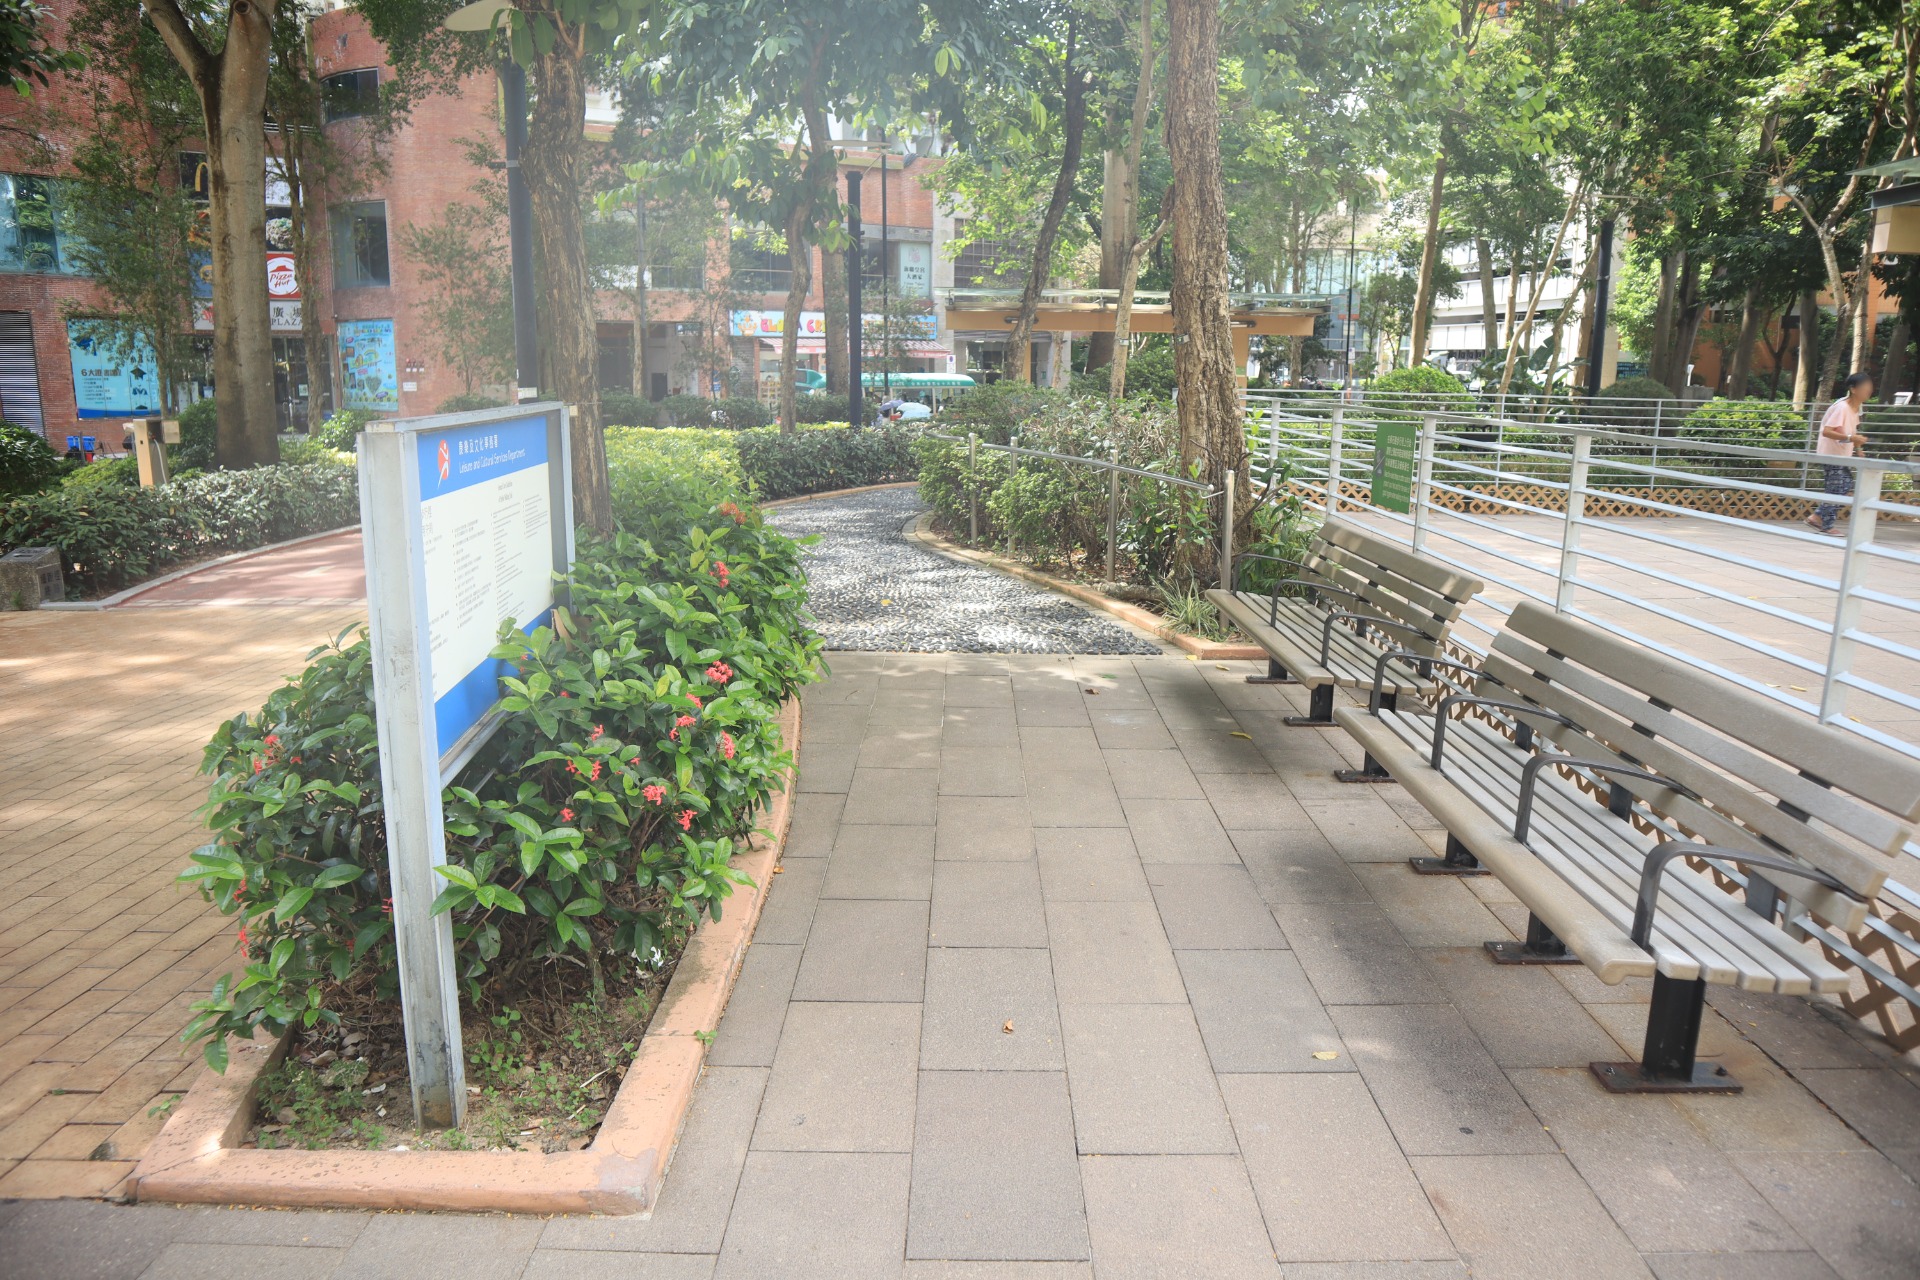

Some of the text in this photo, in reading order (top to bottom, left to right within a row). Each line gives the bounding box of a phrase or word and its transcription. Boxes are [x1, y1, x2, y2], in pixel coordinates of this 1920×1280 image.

[269, 272, 293, 284] Pizza
[274, 278, 291, 288] Hut
[459, 461, 473, 474] Leisure
[480, 455, 494, 468] Cultural
[494, 452, 508, 465] Services
[507, 448, 526, 463] Department
